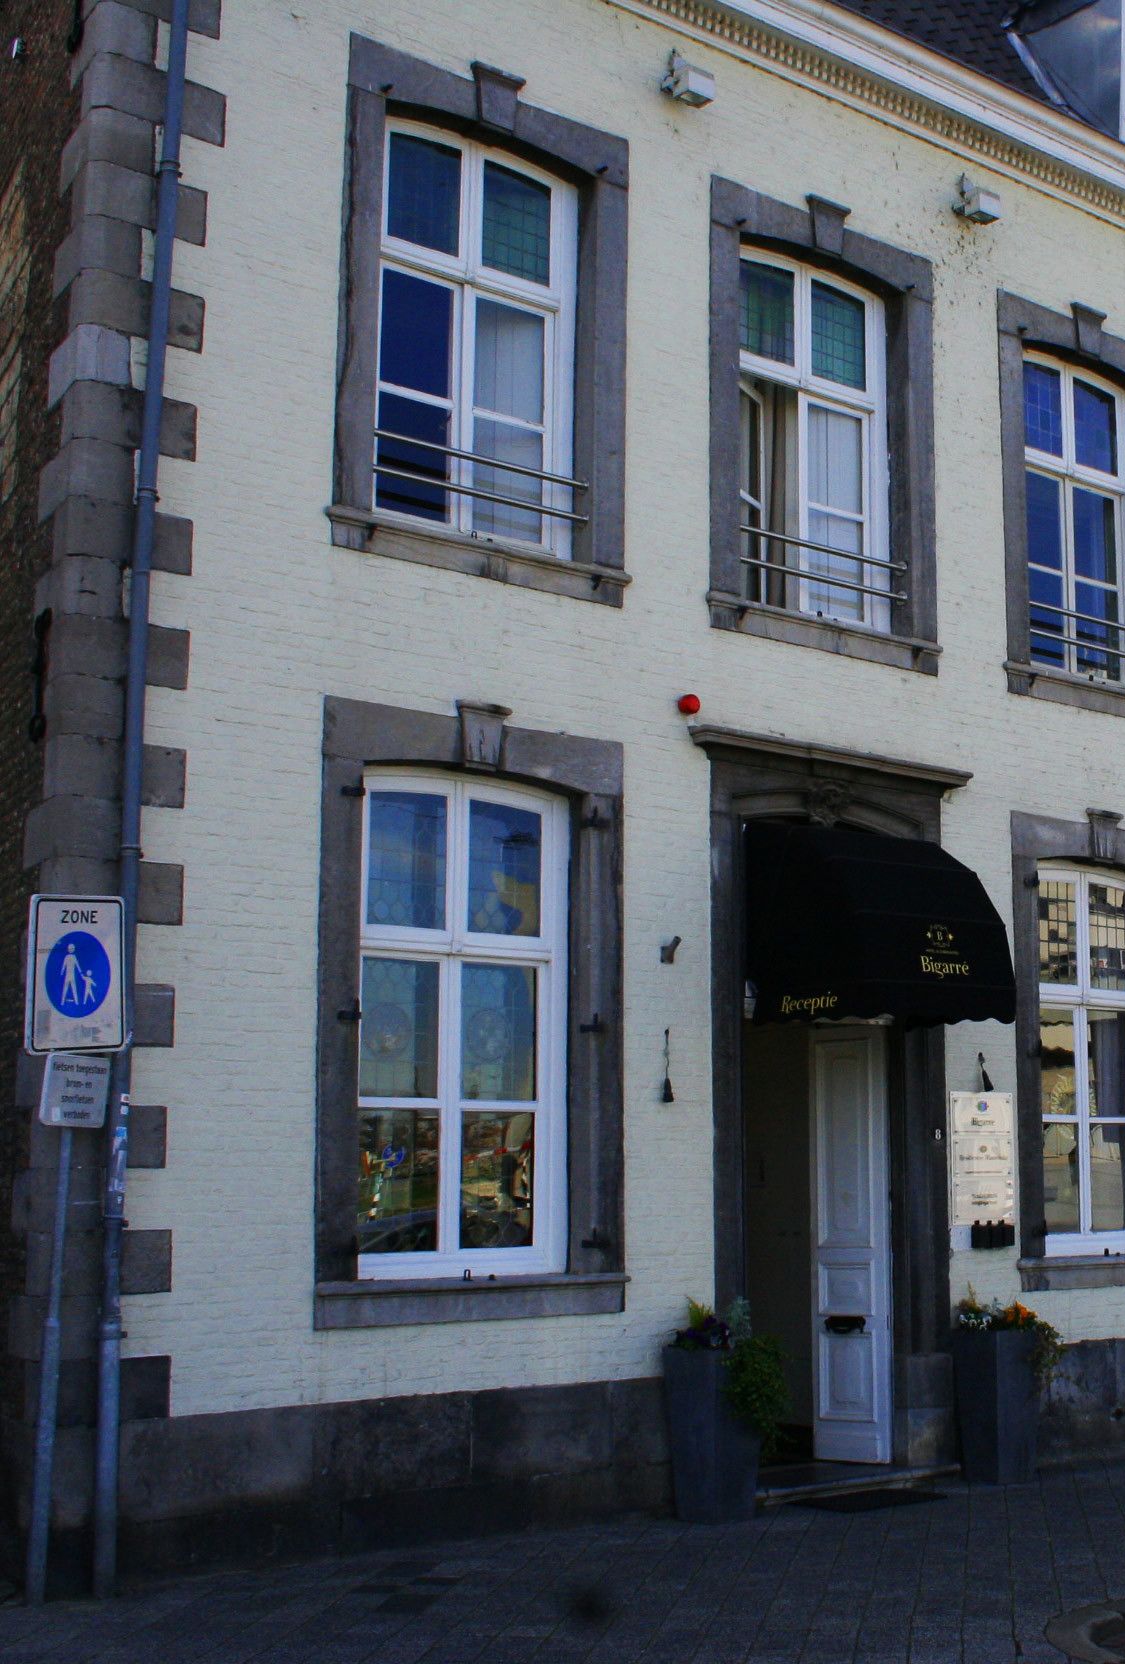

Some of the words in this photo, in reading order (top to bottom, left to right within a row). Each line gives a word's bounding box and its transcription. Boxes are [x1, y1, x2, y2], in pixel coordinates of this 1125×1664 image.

[61, 910, 98, 924] ZONE
[920, 955, 970, 979] Bigarré
[781, 991, 838, 1015] Receptie
[935, 1128, 942, 1141] 8
